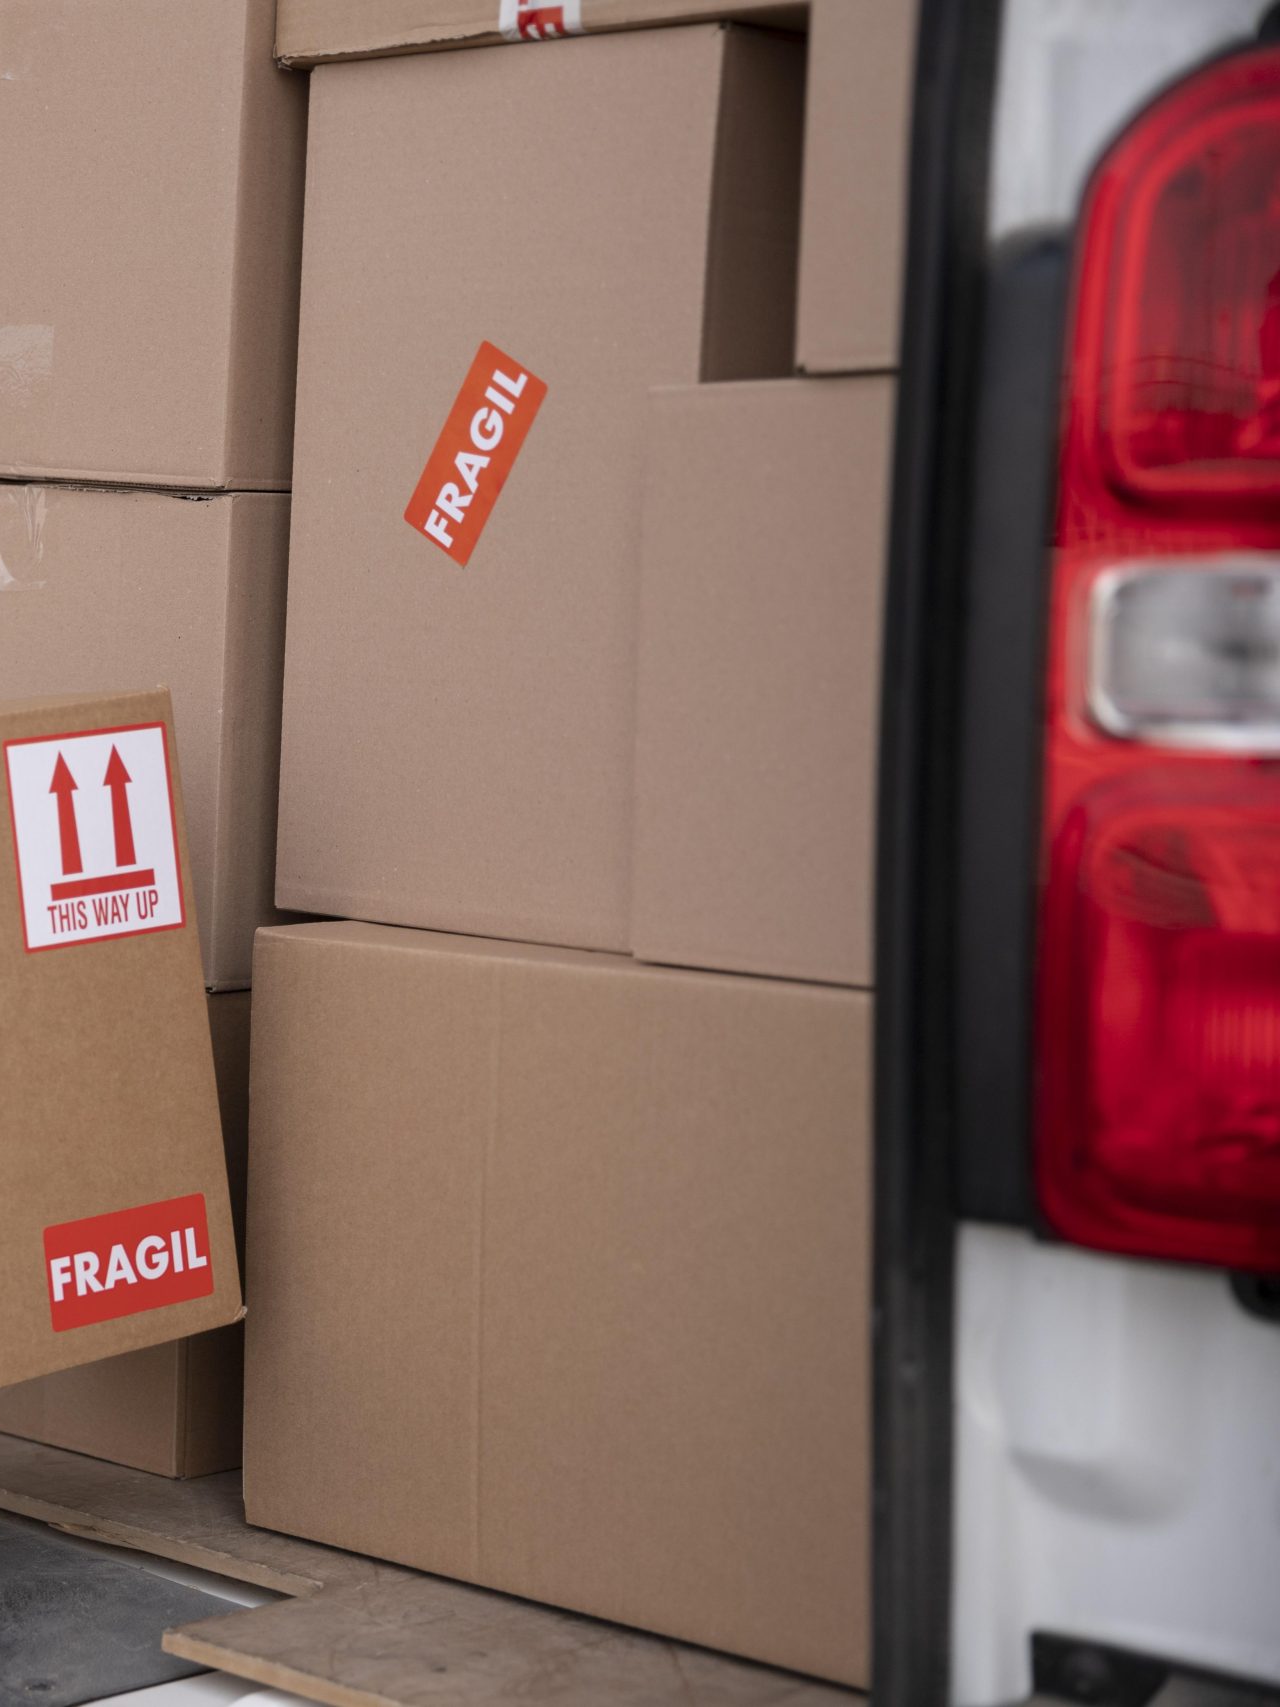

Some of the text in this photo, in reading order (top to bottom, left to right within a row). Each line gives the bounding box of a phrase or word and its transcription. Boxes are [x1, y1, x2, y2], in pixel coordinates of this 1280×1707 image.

[423, 368, 528, 548] FRAGIL
[46, 889, 159, 934] THIS WAY UP
[50, 1227, 208, 1302] FRAGIL
